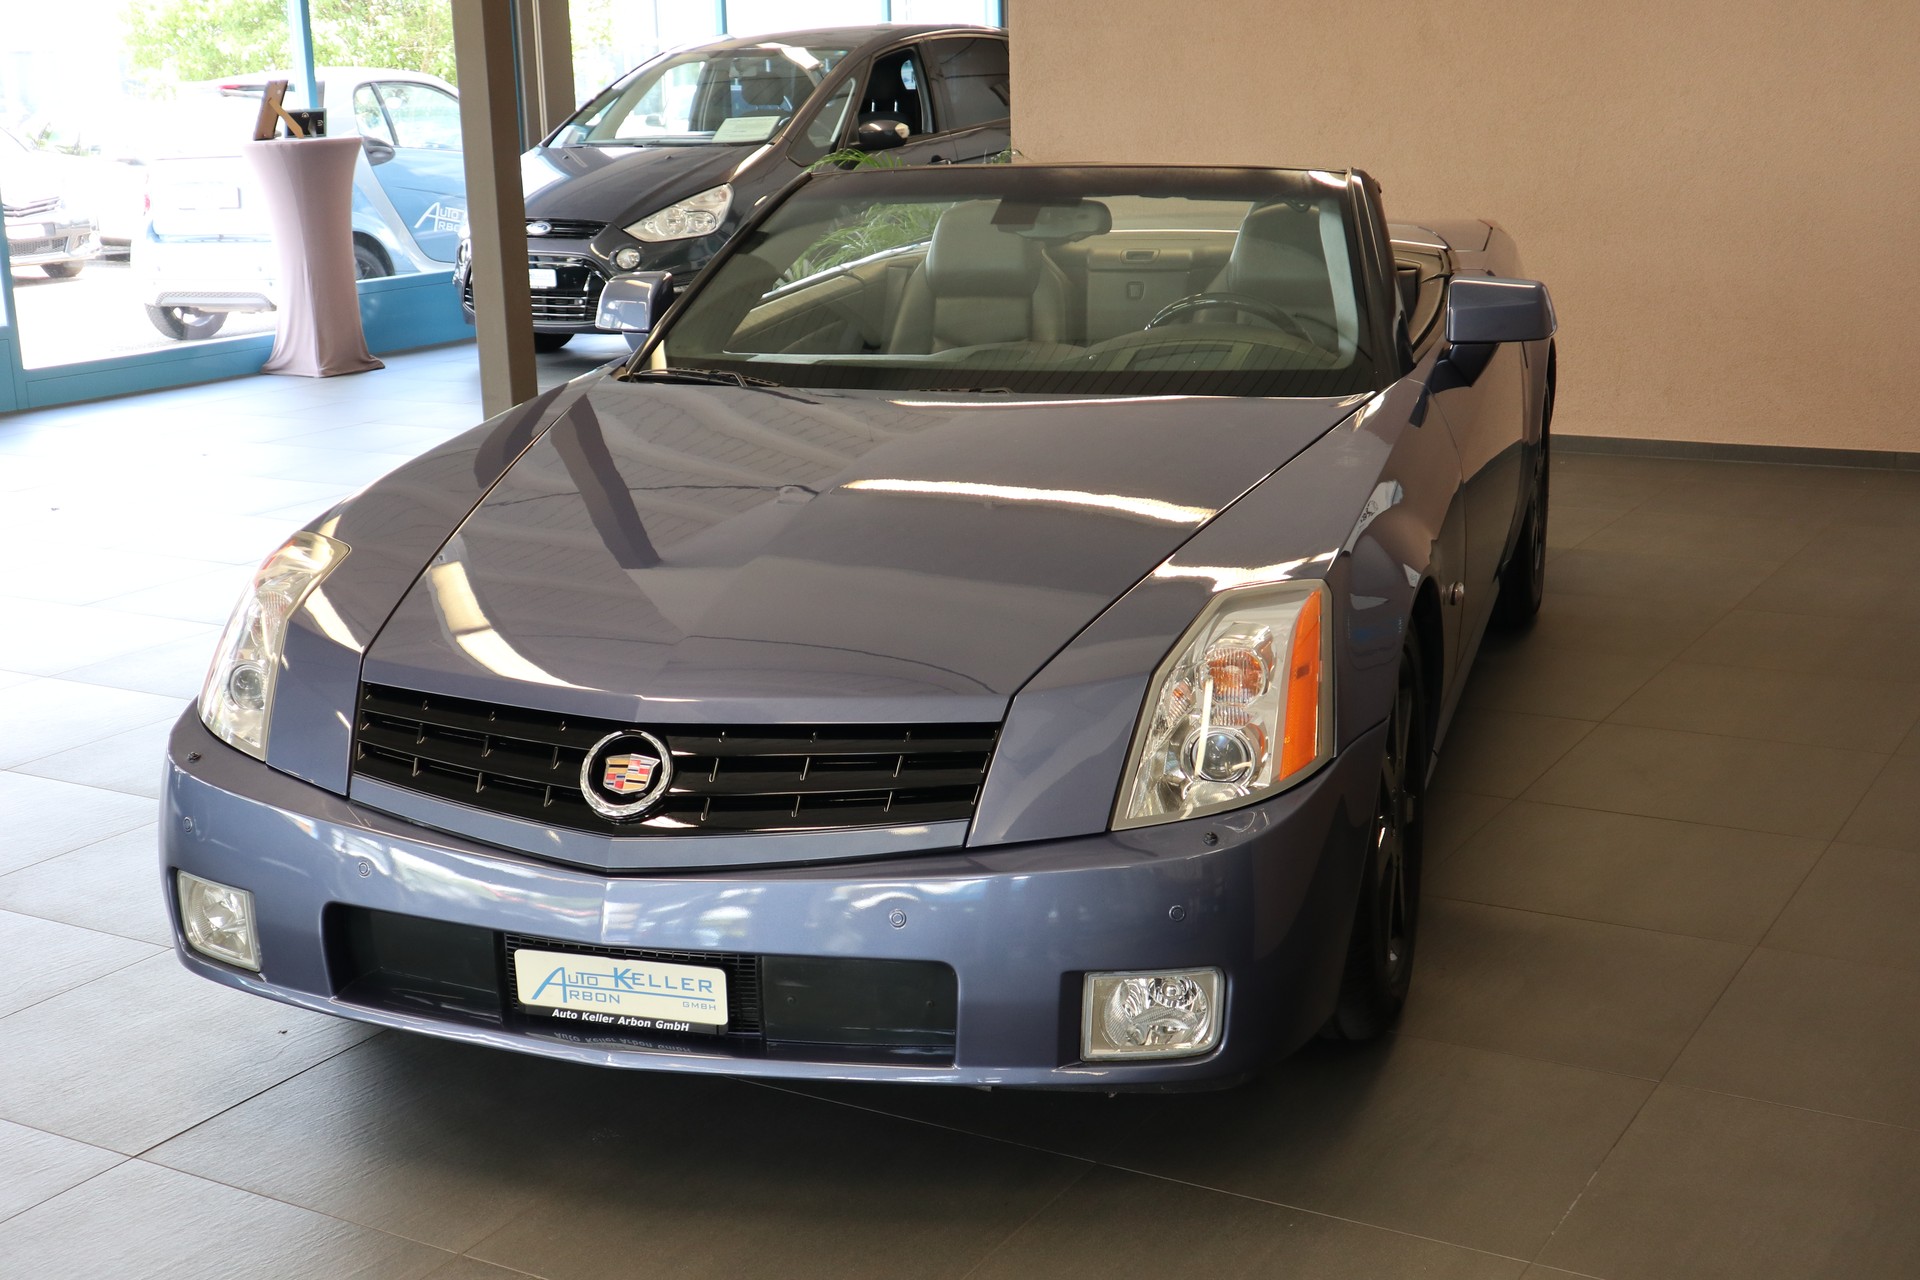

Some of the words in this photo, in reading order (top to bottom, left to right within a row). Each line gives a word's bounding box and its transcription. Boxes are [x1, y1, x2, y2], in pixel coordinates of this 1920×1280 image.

[531, 967, 599, 1003] AUTO
[614, 967, 713, 994] KELLER
[552, 1008, 578, 1020] Auto
[581, 1011, 615, 1024] Keller
[617, 1016, 651, 1028] Arbon
[656, 1020, 690, 1032] GmbH
